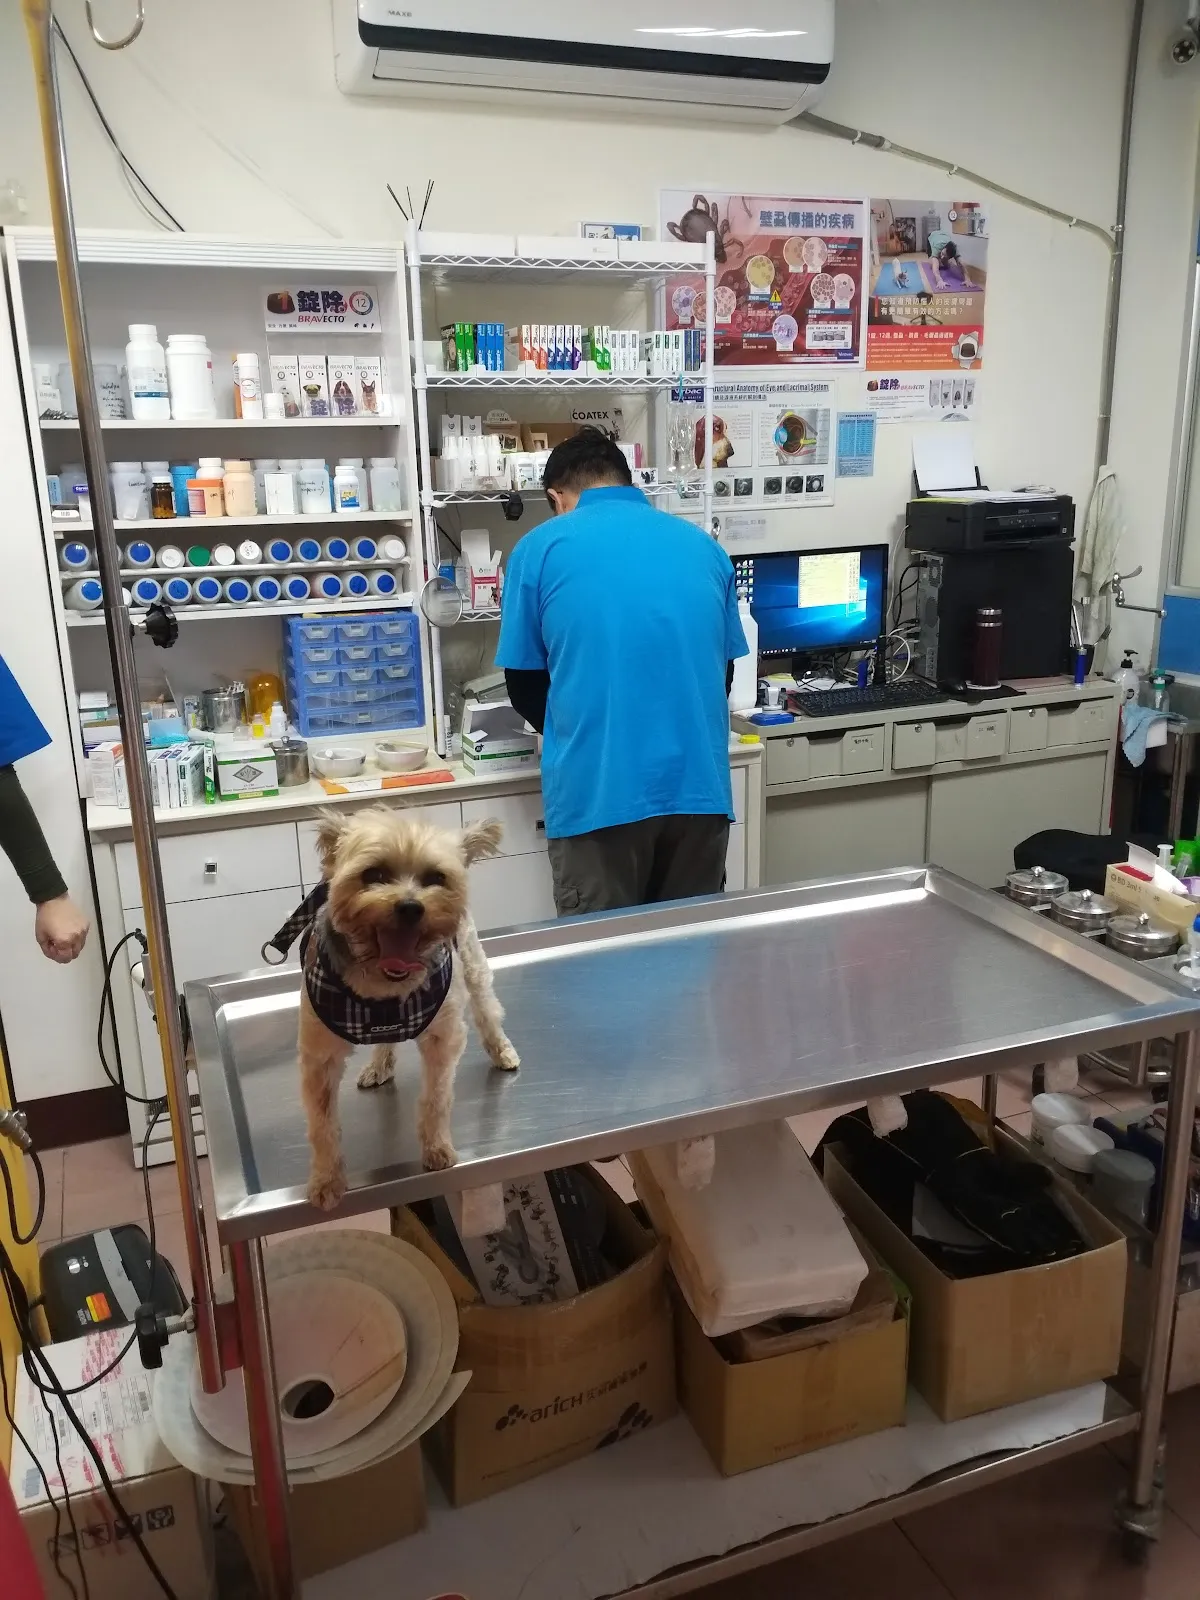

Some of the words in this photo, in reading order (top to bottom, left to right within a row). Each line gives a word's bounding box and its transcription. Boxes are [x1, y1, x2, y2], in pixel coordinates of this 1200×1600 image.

[297, 291, 346, 313] 錠除
[356, 298, 367, 308] 12
[298, 315, 345, 323] BRAVECTO
[737, 385, 758, 393] Anatomy
[766, 384, 776, 393] Eye
[811, 384, 829, 393] System
[572, 411, 609, 420] COATEX
